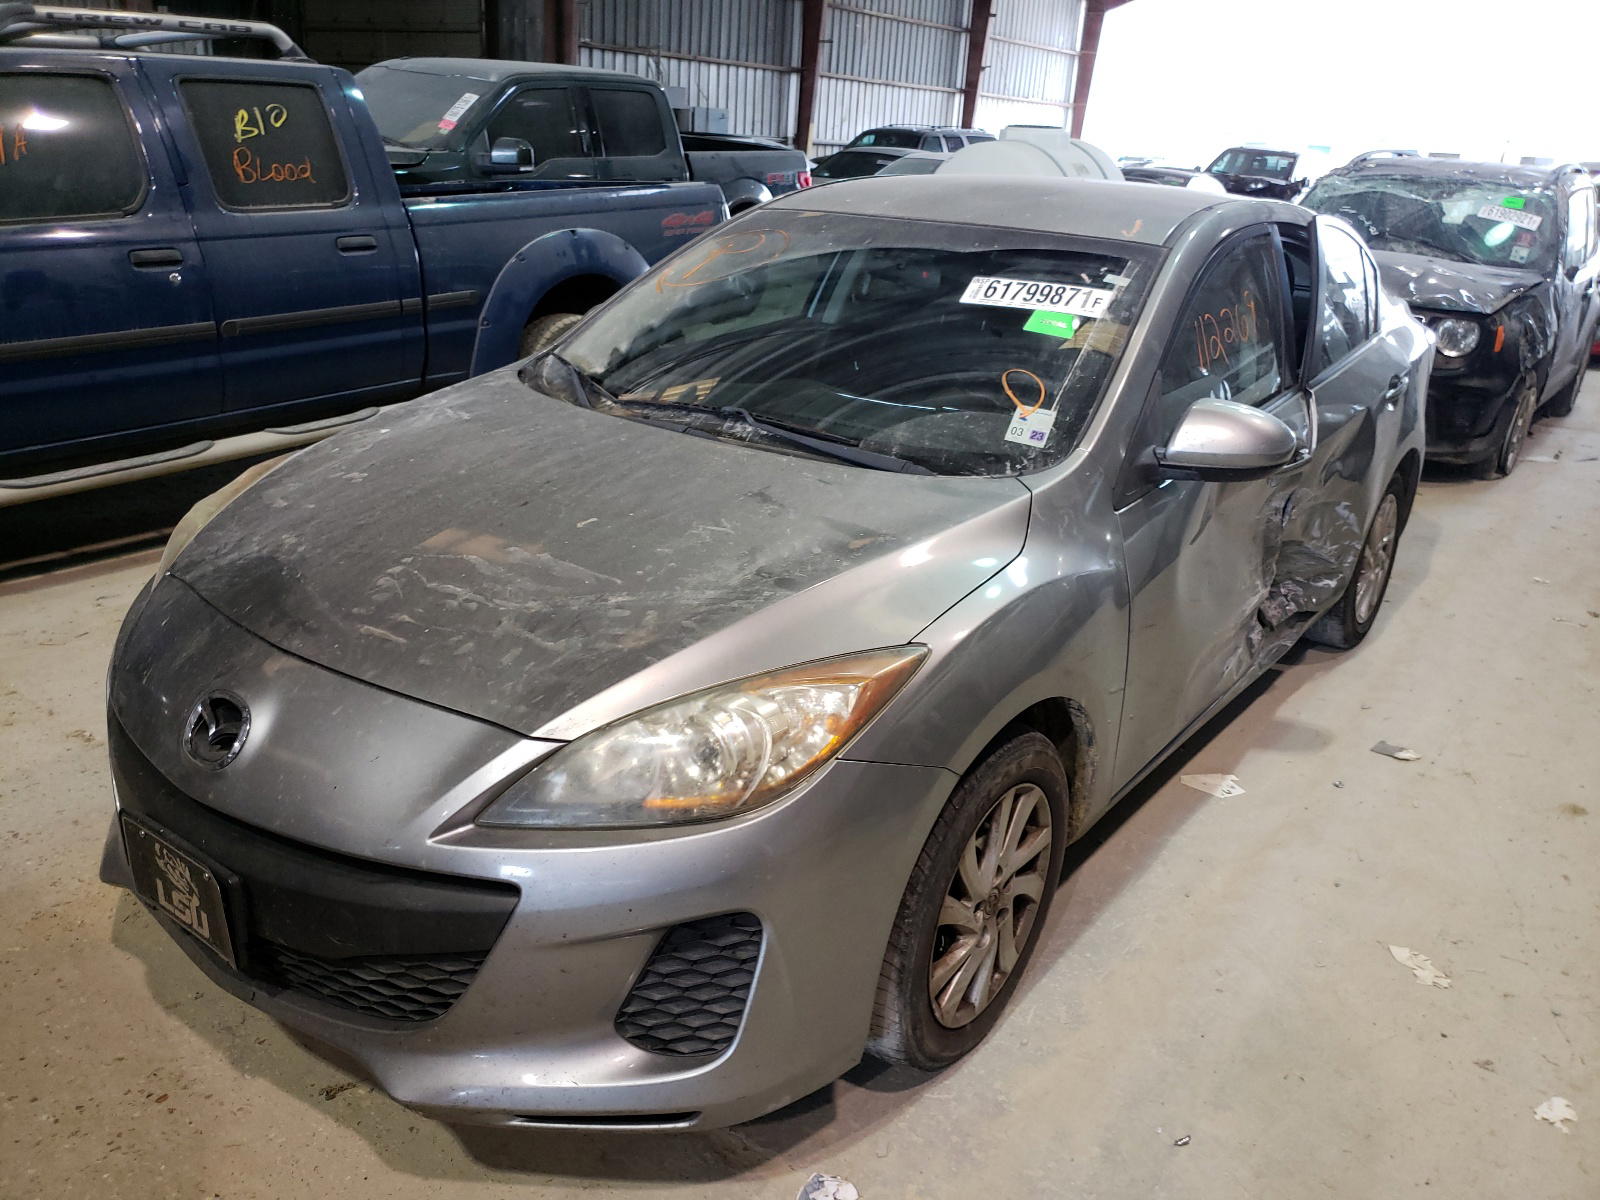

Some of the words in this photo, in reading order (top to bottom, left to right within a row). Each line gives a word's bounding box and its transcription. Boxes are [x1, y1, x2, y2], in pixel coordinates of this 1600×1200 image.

[46, 12, 163, 26] CREW
[178, 20, 252, 33] CAB
[983, 279, 1093, 309] 61799871
[1010, 426, 1025, 437] 03
[1030, 430, 1045, 442] 23
